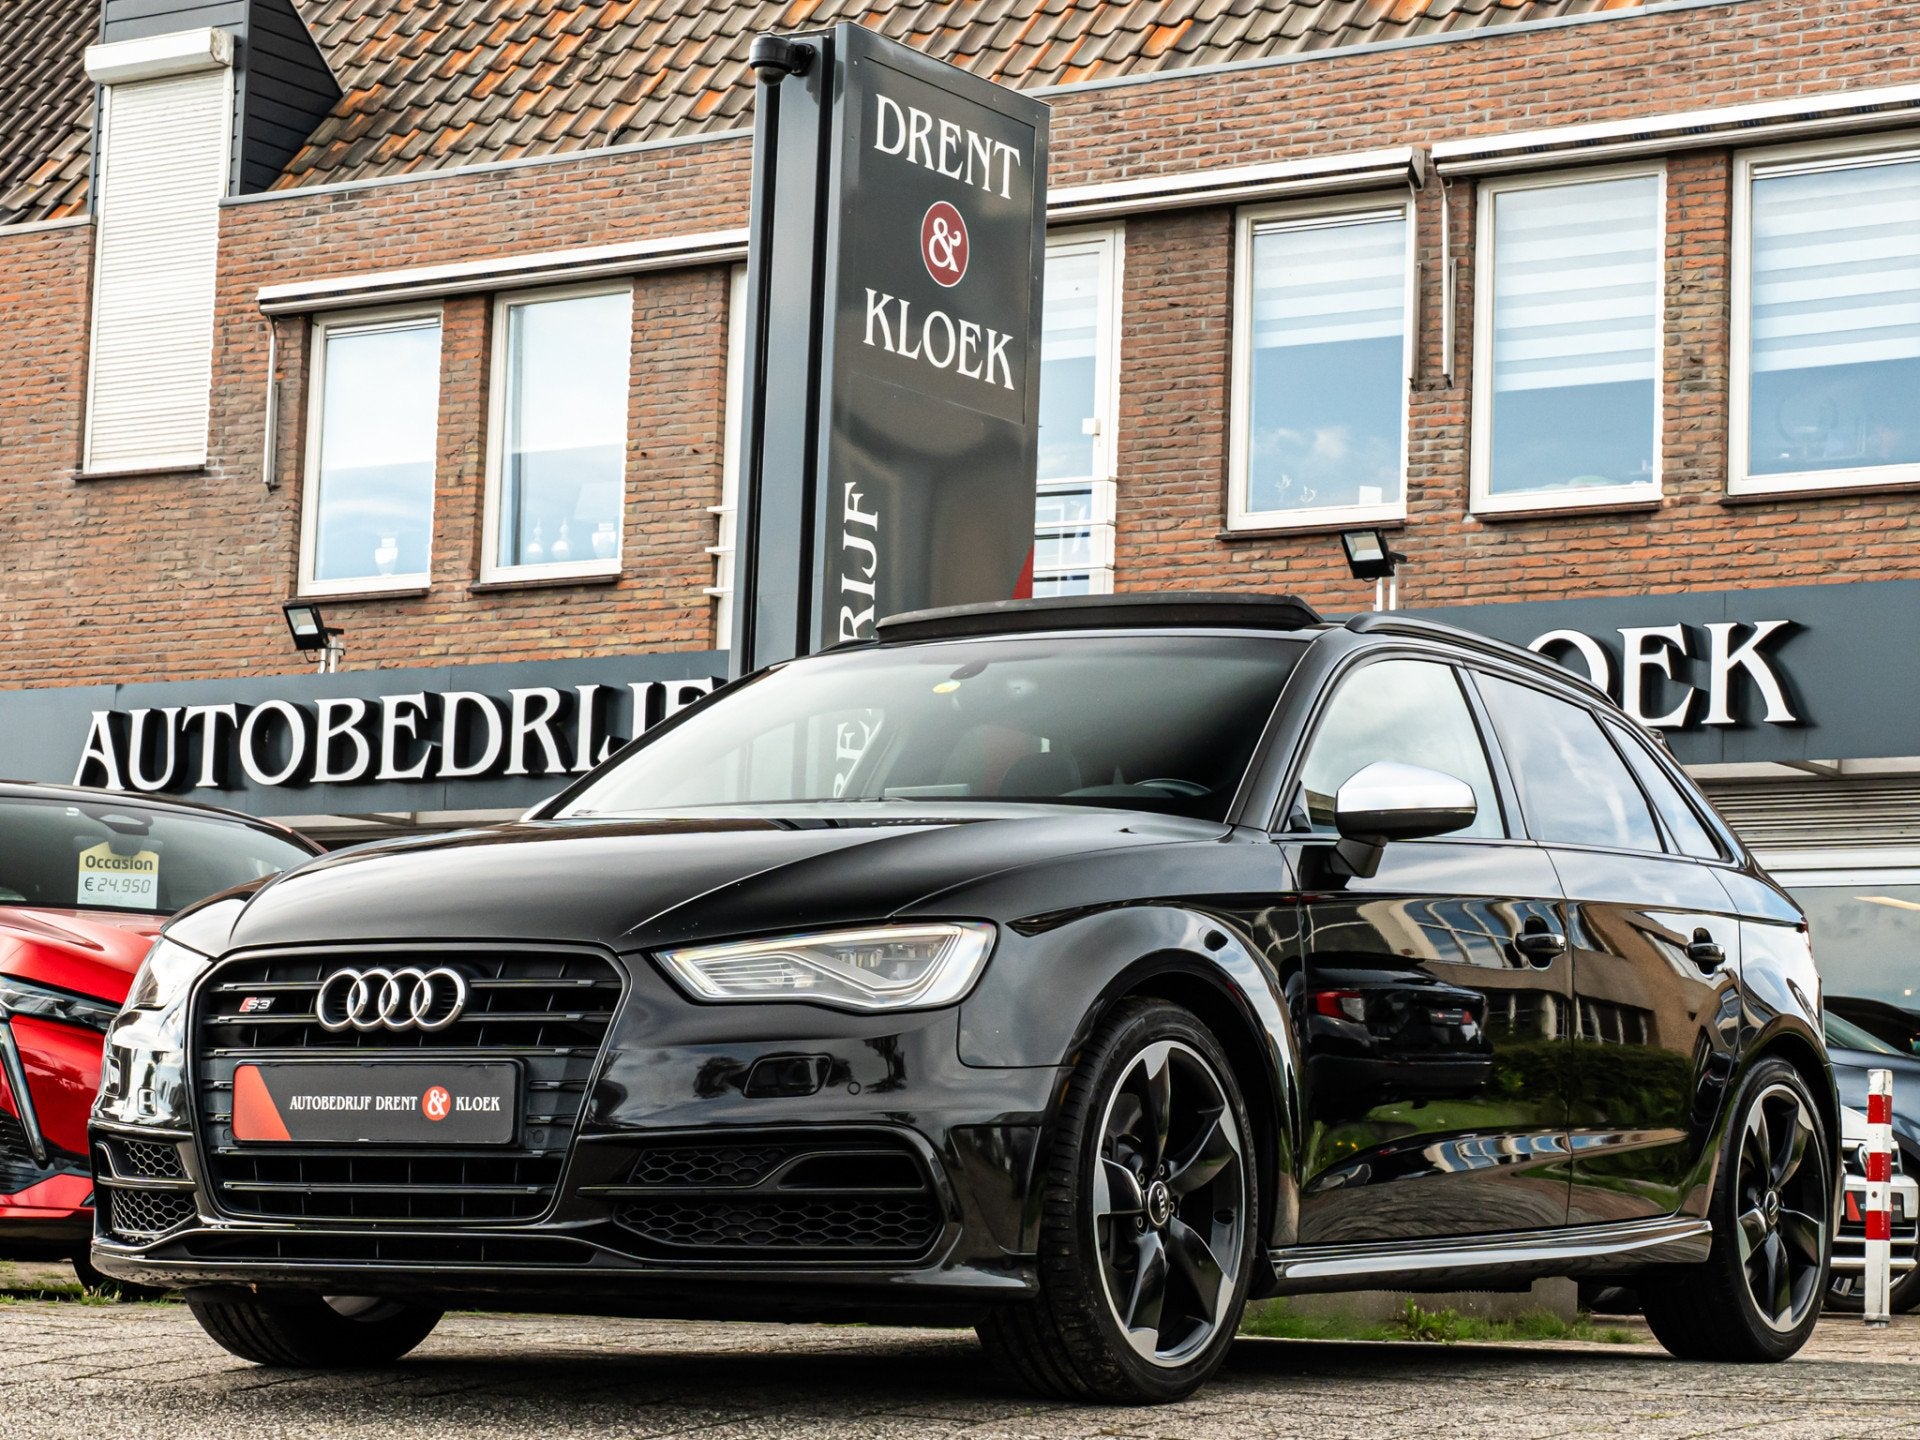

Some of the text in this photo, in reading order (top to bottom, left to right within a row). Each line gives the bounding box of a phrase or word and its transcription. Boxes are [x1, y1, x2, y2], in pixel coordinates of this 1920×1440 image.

[873, 93, 1021, 200] DRENT
[928, 217, 962, 272] &
[863, 287, 1015, 391] KLOEK
[85, 855, 153, 870] Occasion
[97, 878, 151, 893] 24.950
[289, 1089, 500, 1116] AUTOBEDRIJF DRENT & KLOEK
